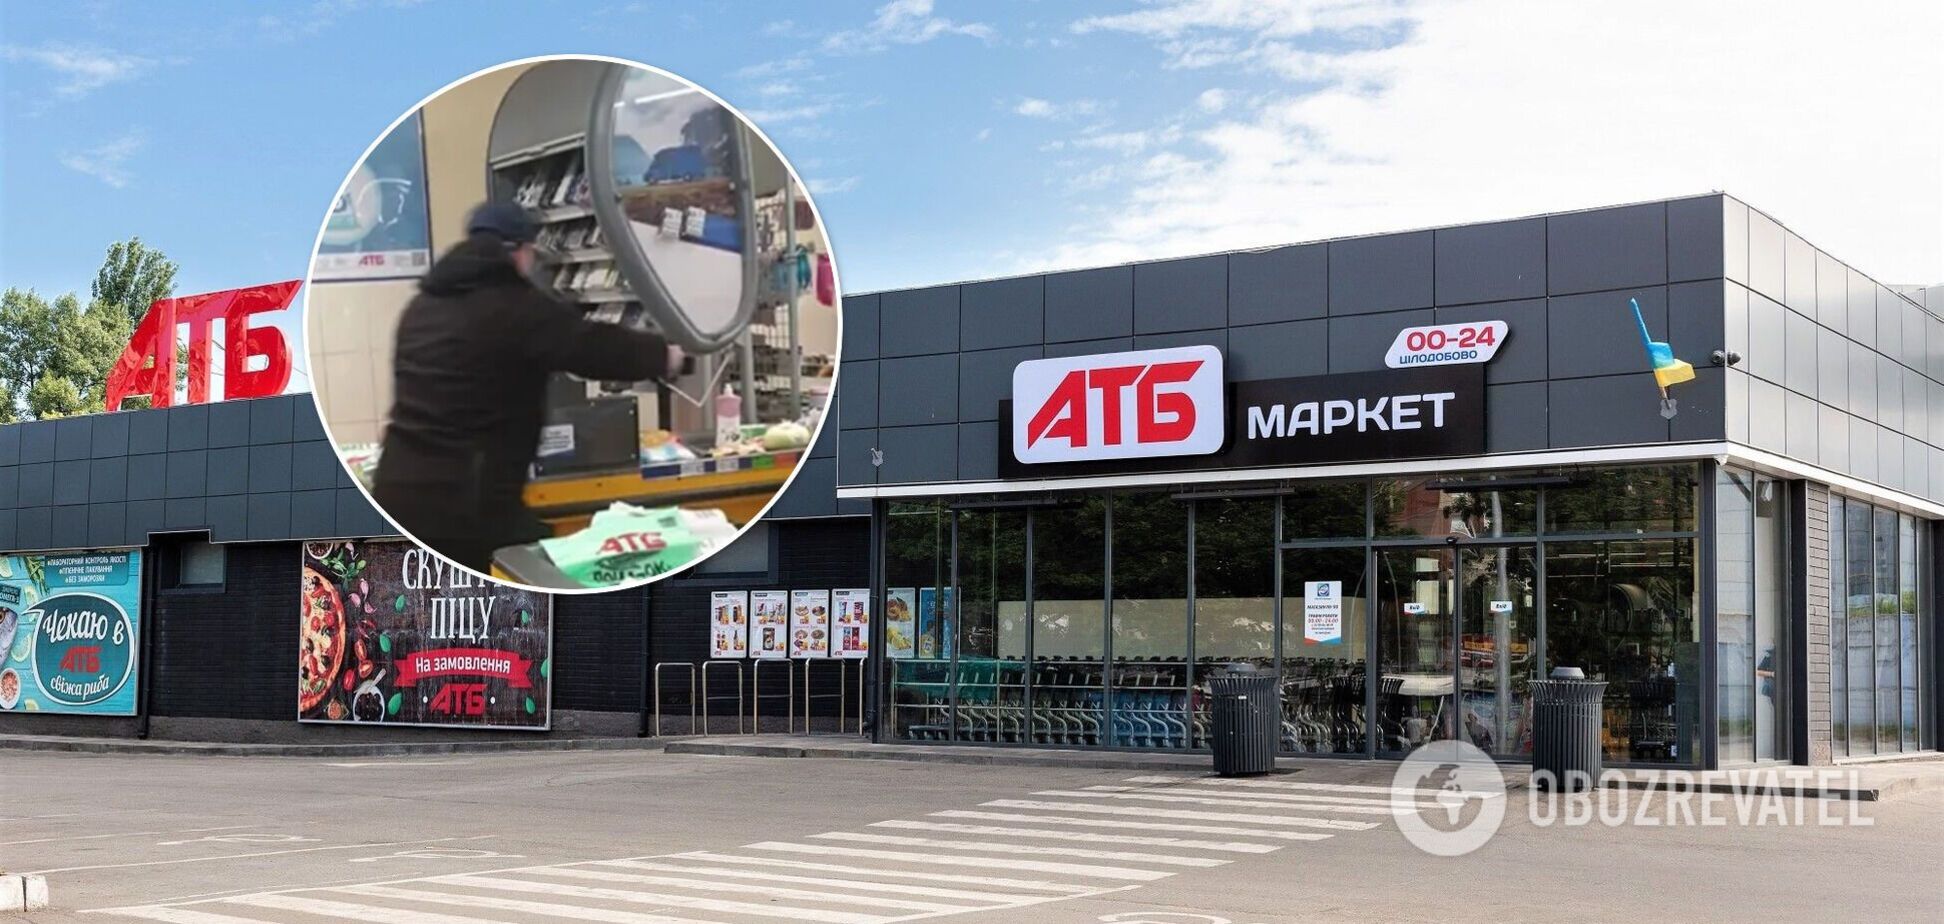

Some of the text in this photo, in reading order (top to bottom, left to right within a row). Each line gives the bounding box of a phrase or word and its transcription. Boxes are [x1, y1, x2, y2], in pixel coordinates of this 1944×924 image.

[106, 279, 304, 412] АТБ
[1407, 326, 1495, 351] 00-24
[1400, 350, 1478, 365] ЦІЛОДОБОВО
[1027, 360, 1205, 450] АТБ
[1246, 392, 1456, 440] МАРКЕТ
[43, 609, 124, 645] Чекаю в
[431, 596, 496, 644] ПІЦУ
[60, 646, 101, 673] АТБ
[415, 656, 511, 674] На замовлення
[51, 674, 109, 701] свіжа риба
[431, 683, 488, 715] АТБ
